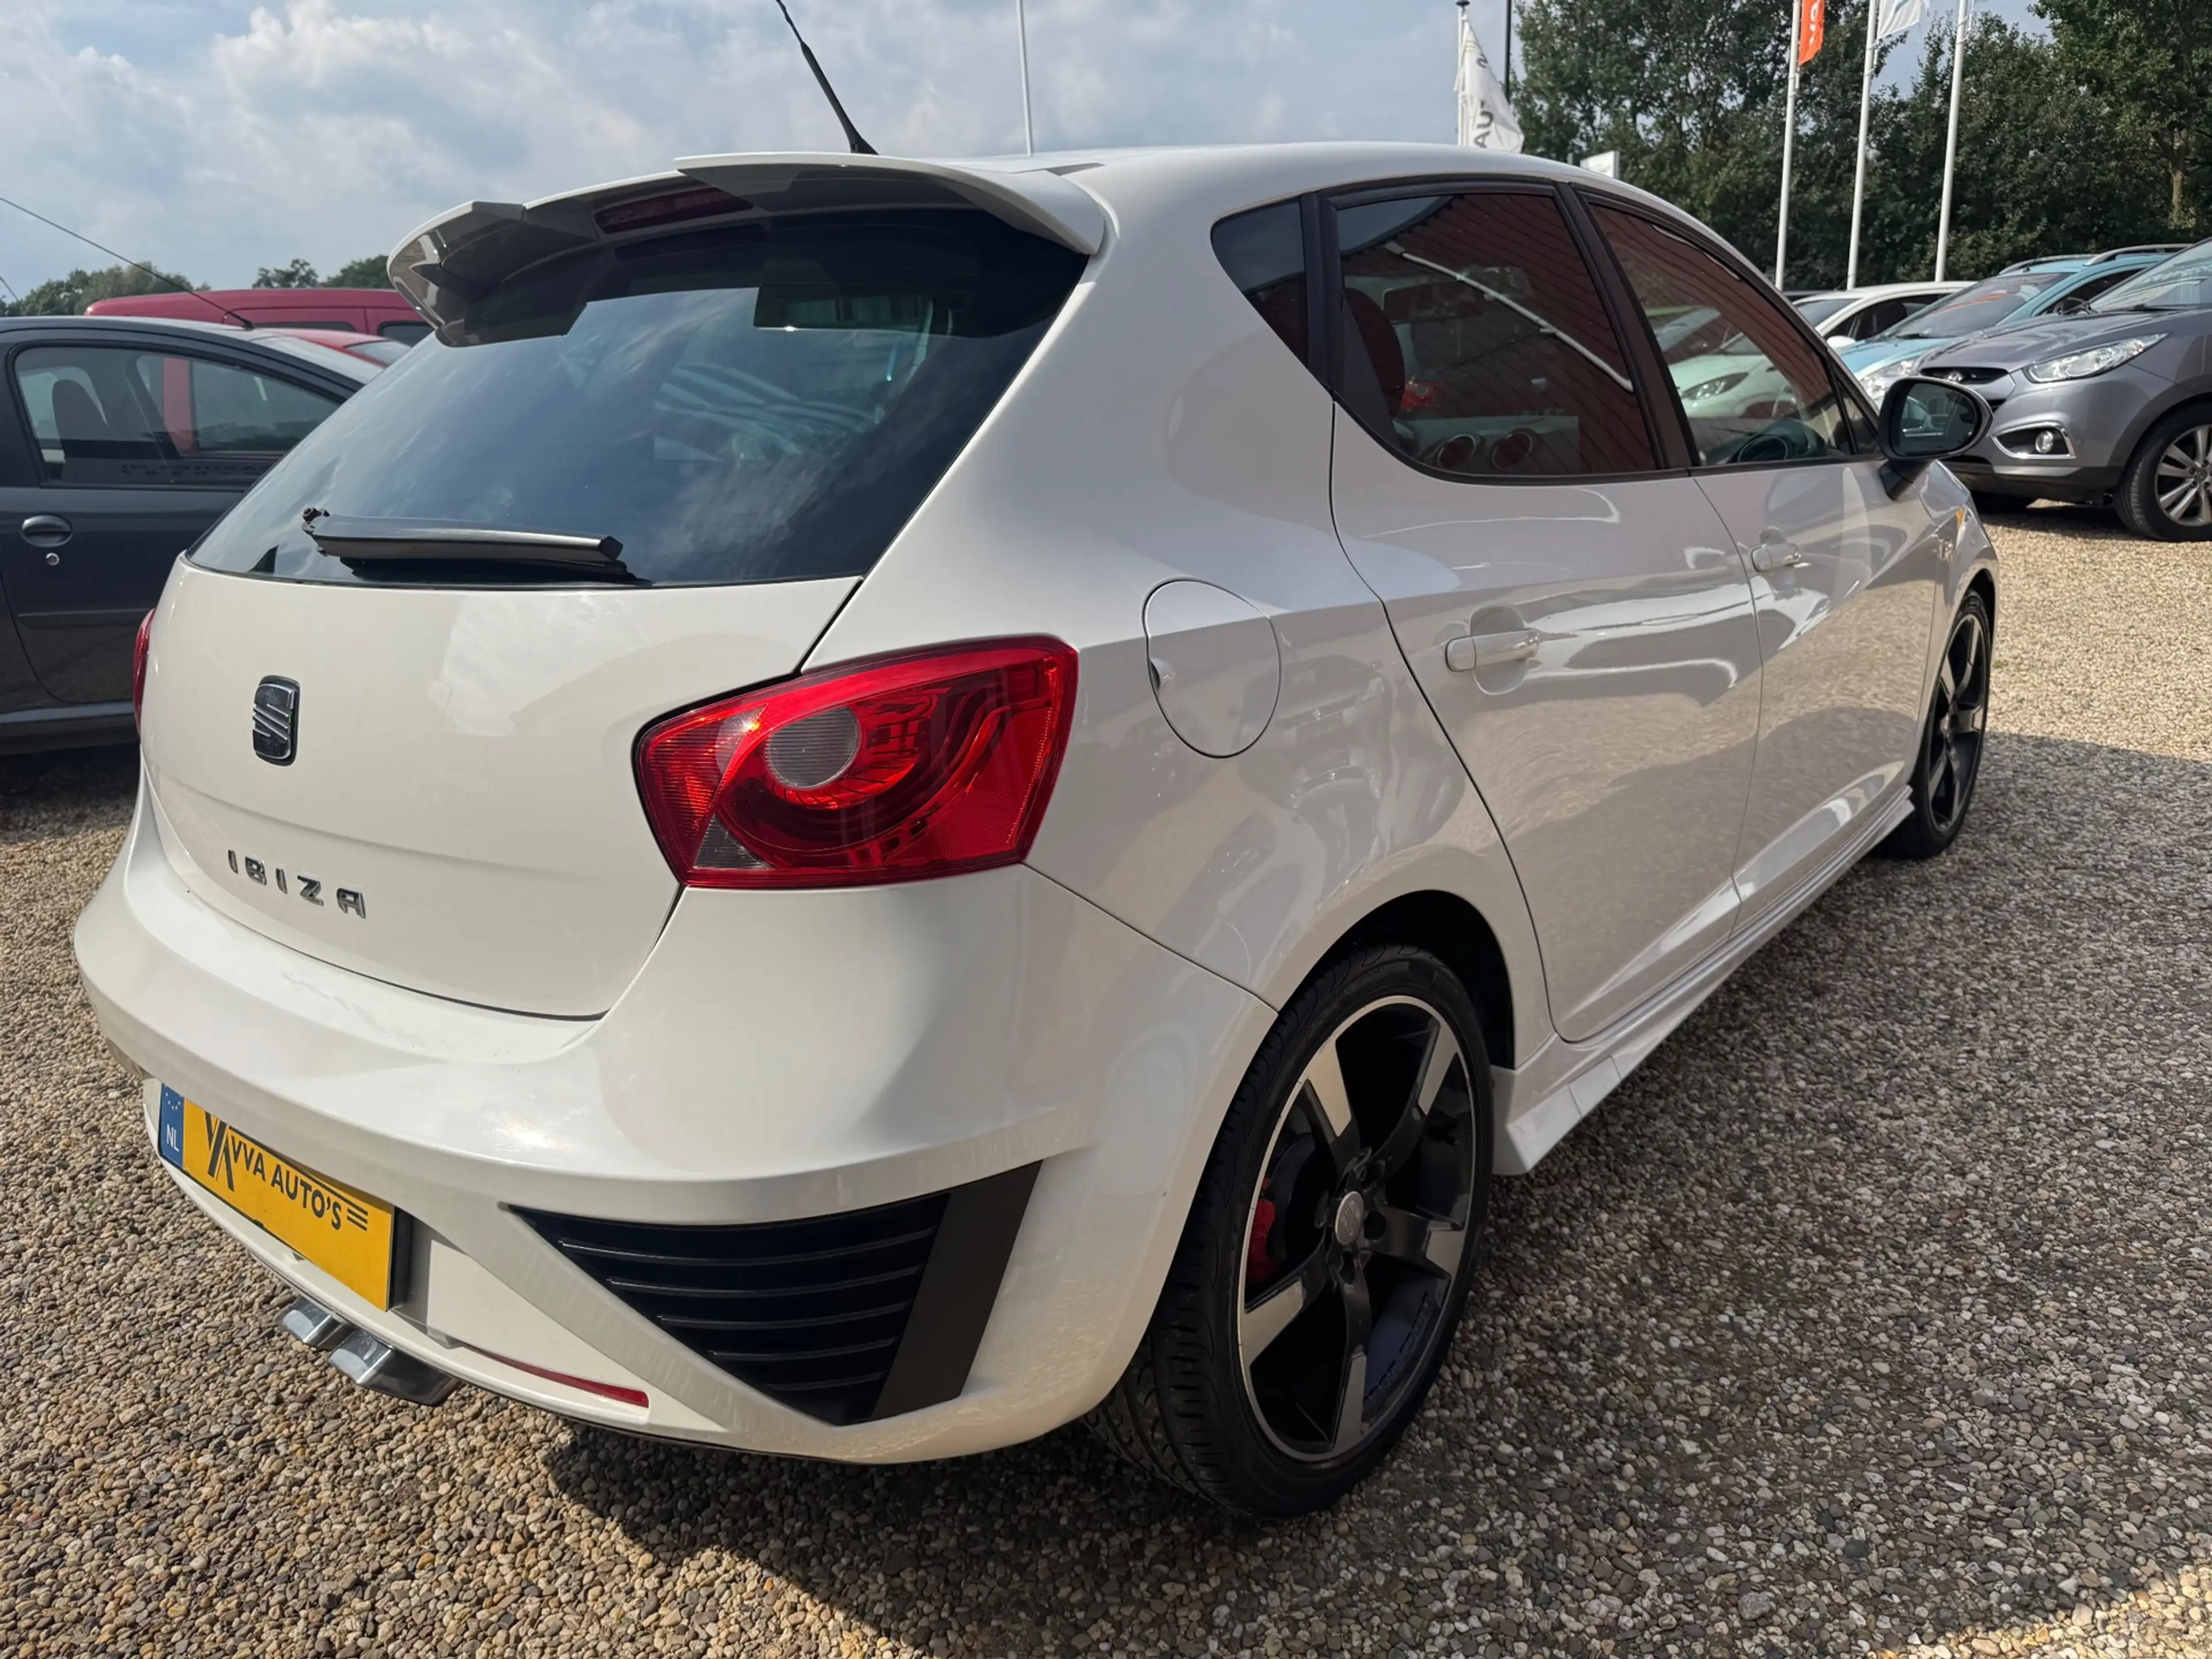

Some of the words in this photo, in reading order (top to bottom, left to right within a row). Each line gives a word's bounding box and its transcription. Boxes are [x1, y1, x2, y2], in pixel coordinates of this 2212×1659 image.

[228, 849, 366, 919] IBIZA
[166, 1124, 180, 1152] NL
[271, 1163, 342, 1230] AUTO'S
